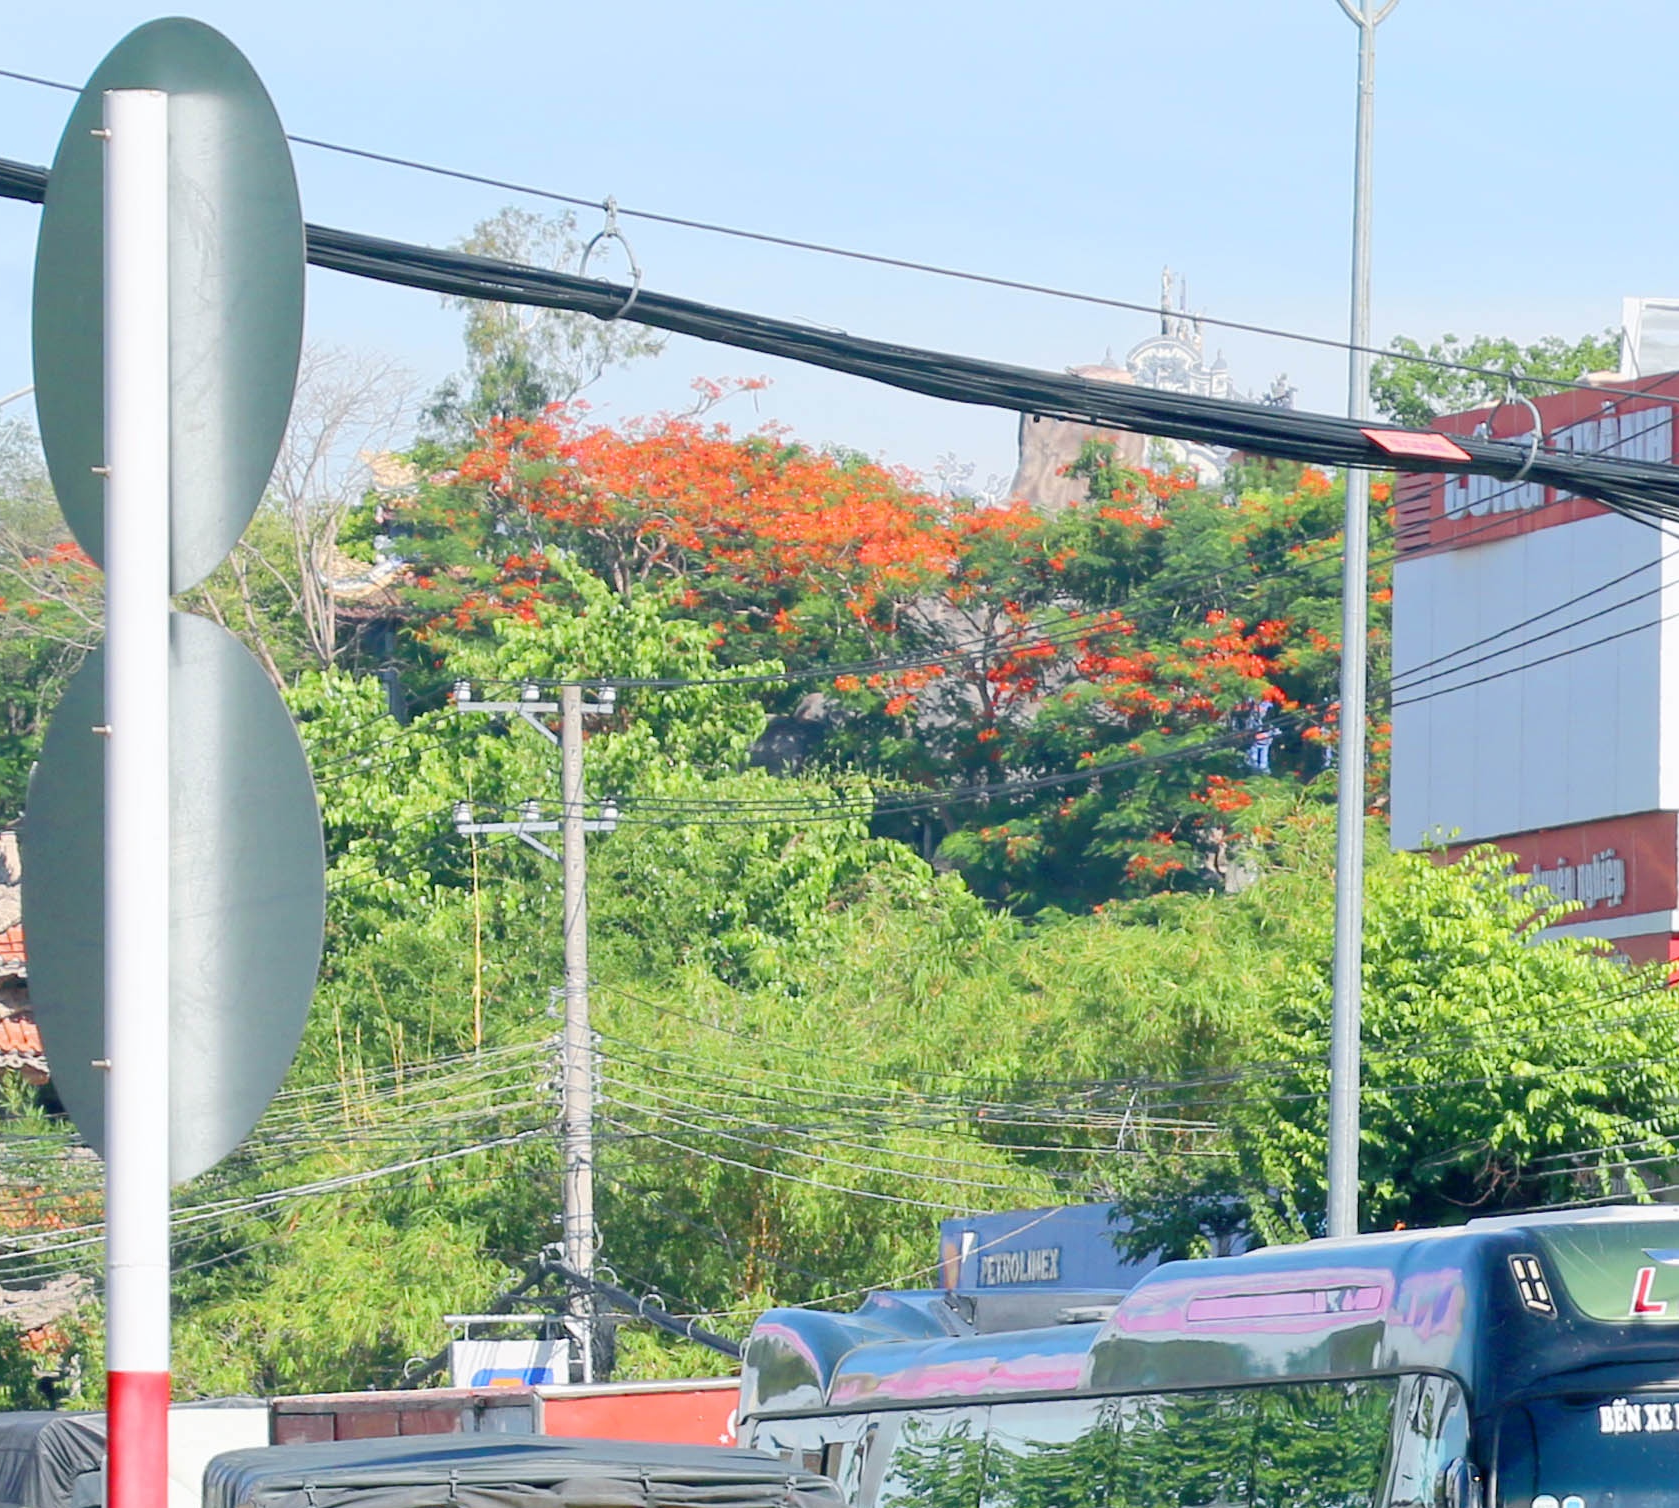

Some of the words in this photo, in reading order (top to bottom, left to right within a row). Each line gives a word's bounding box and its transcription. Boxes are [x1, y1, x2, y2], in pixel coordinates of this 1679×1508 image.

[981, 1249, 1061, 1285] PETROLIMEX
[1599, 1397, 1641, 1433] BẾN
[1643, 1402, 1673, 1433] XE
